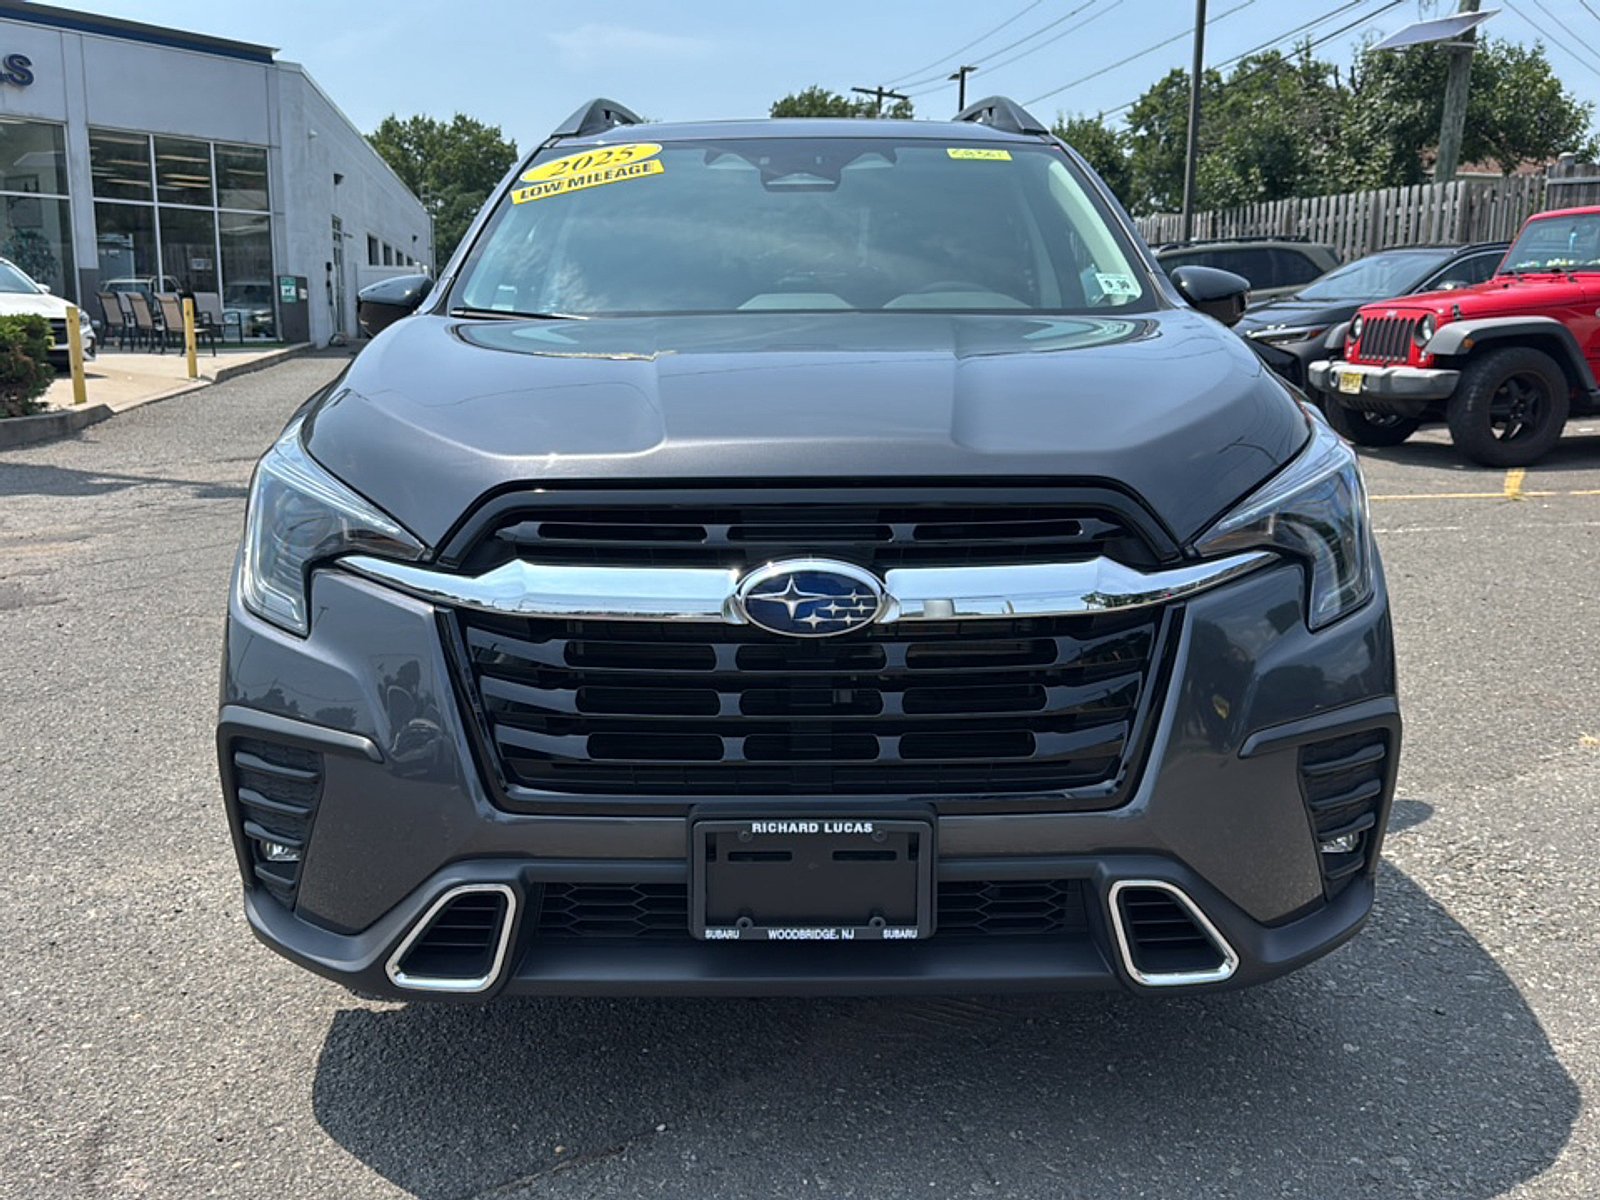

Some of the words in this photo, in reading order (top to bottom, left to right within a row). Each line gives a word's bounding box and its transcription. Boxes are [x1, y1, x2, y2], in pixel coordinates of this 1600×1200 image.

[549, 146, 637, 177] 2025
[520, 181, 564, 200] LOW
[567, 162, 655, 188] MILEAGE
[751, 822, 819, 833] RICHARD
[824, 822, 873, 833] LUCAS
[704, 929, 740, 939] SUBARU
[841, 929, 855, 939] NJ
[883, 929, 918, 939] SUBARU
